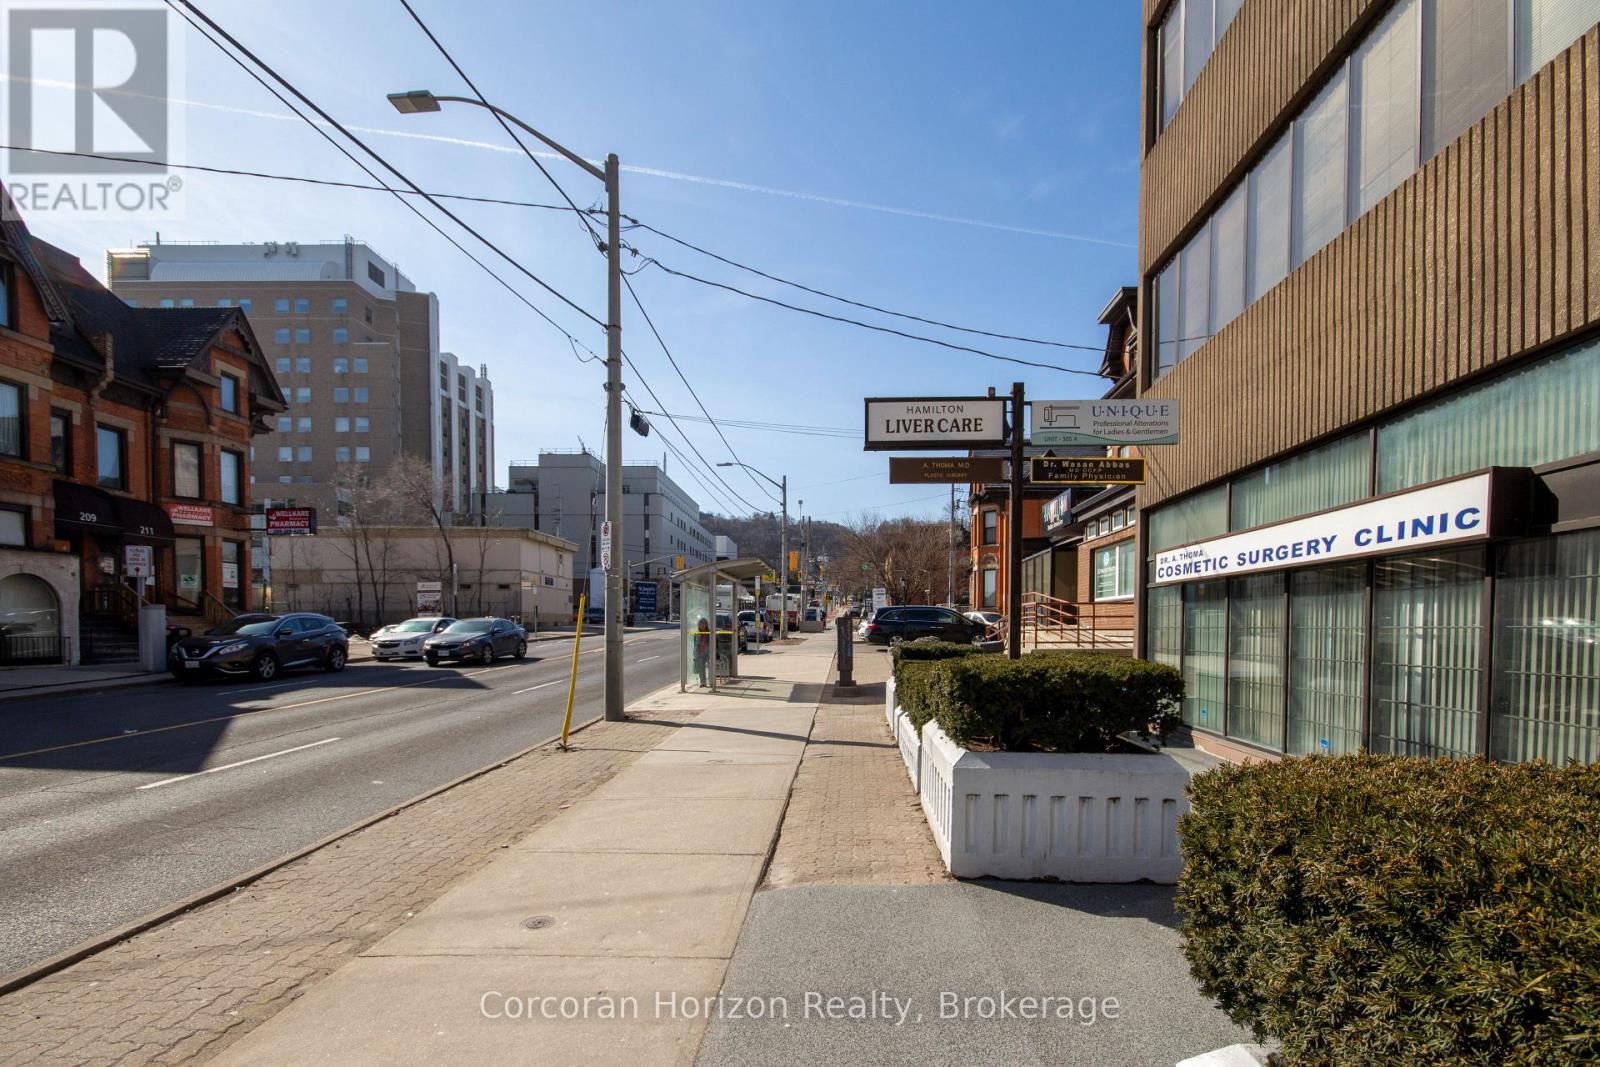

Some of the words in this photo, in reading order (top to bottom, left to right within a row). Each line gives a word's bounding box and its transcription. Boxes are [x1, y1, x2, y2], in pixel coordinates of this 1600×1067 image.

[906, 405, 964, 414] HAMILTON
[885, 418, 935, 433] LIVER
[937, 417, 984, 432] CARE
[1048, 472, 1077, 480] Family
[1082, 472, 1126, 480] Physician
[80, 512, 97, 522] 209
[269, 520, 309, 528] PHARMACY
[140, 526, 154, 536] 211
[1157, 555, 1229, 579] COSMETIC
[1237, 534, 1338, 567] SURGERY
[1354, 507, 1481, 547] CLINIC
[1180, 549, 1204, 560] THOMA
